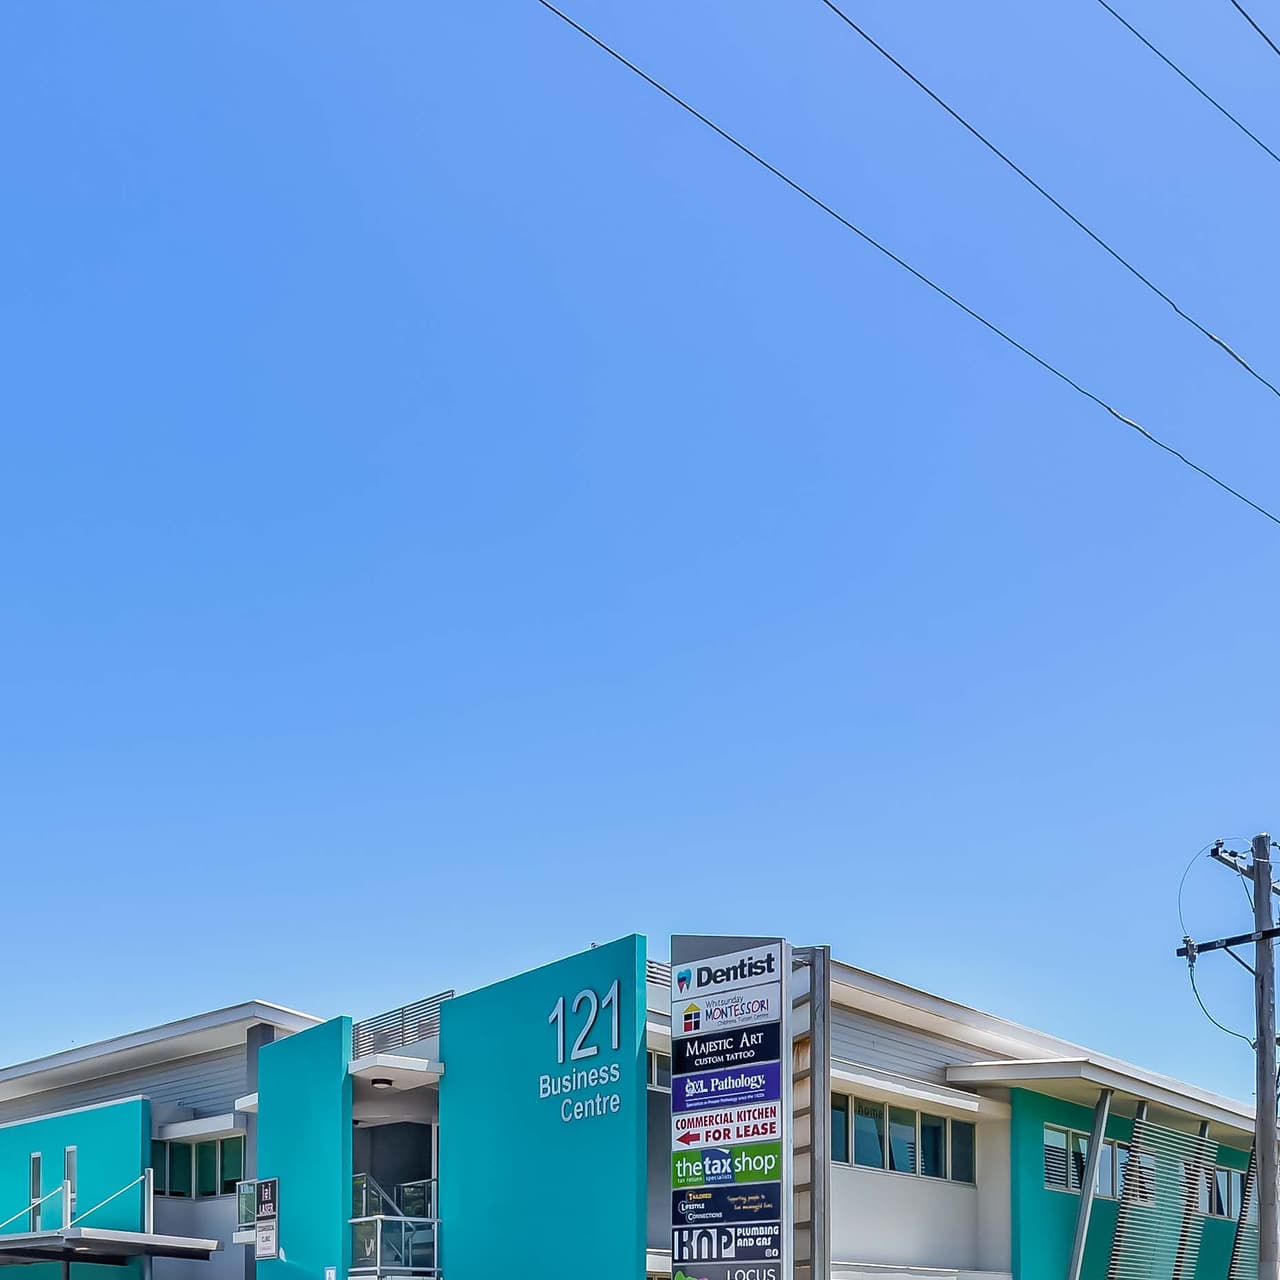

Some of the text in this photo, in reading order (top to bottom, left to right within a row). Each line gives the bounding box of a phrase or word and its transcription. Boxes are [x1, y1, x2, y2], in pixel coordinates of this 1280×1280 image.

[697, 953, 775, 988] Dentist
[548, 979, 618, 1064] 121
[705, 998, 769, 1021] MONTESSORI
[686, 1032, 764, 1057] MAJESTIC ART
[694, 1049, 755, 1066] CUSTOM TATTOO
[539, 1063, 620, 1099] Business
[561, 1093, 620, 1122] Centre
[675, 1106, 777, 1131] COMMERCIAL KITCHEN
[705, 1122, 777, 1142] FOR LEASE
[676, 1151, 776, 1177] the tax shop
[737, 1226, 779, 1237] PLUMBING
[737, 1237, 772, 1247] AND GAS
